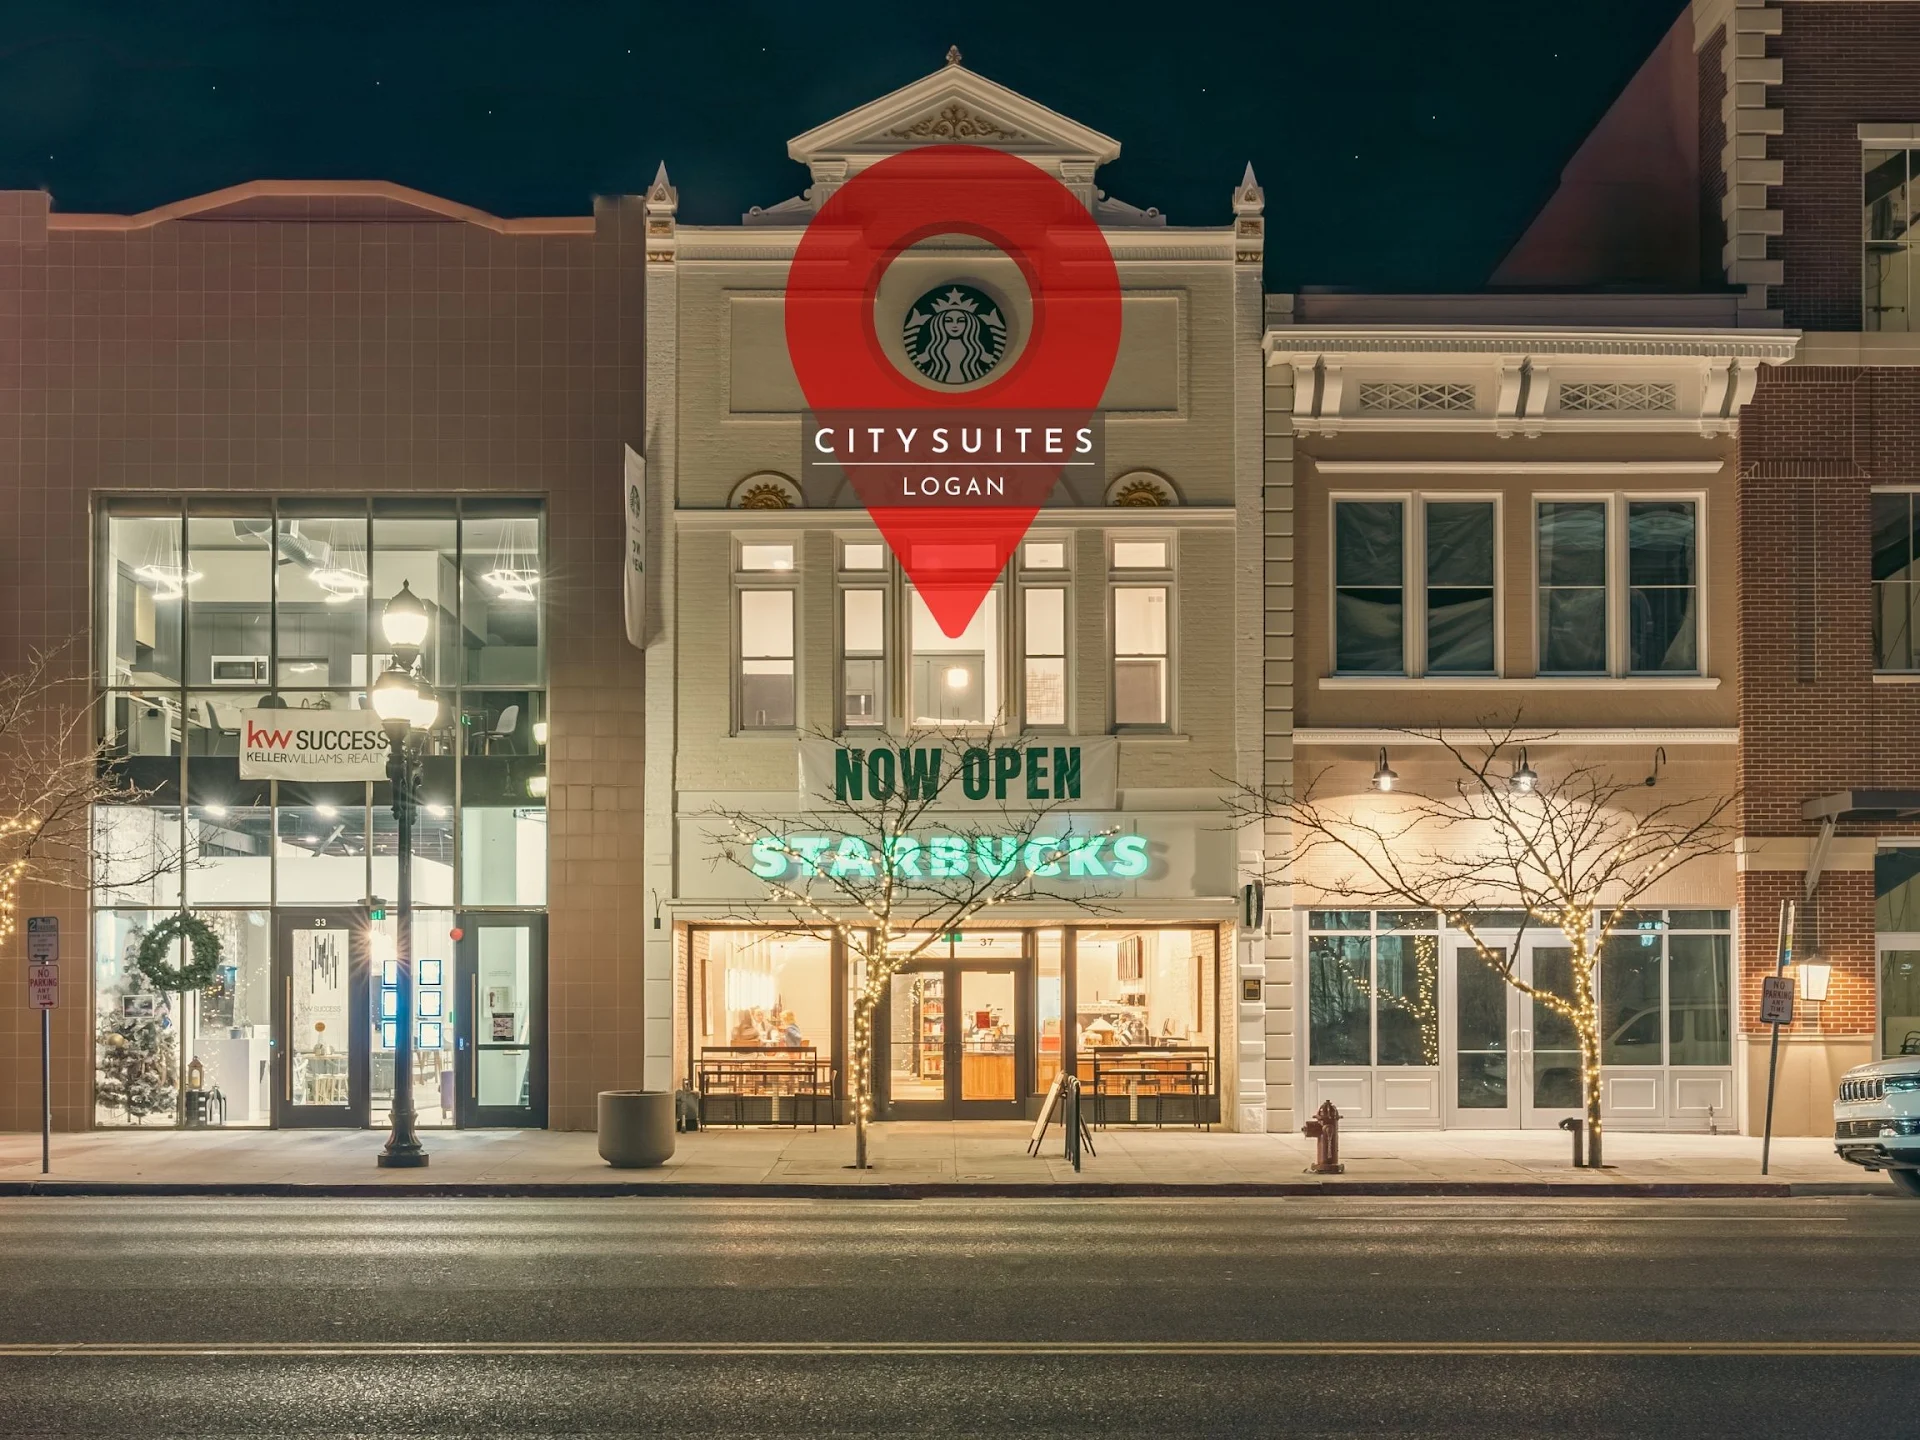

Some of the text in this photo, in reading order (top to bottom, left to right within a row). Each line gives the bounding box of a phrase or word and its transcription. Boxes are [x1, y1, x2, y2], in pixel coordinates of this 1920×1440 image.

[247, 719, 390, 750] kw SUCCESS
[835, 746, 1082, 801] NOW OPEN
[751, 835, 1149, 880] STARBUCKS
[314, 918, 327, 927] 33
[980, 938, 994, 947] 37
[38, 969, 50, 977] NO
[30, 978, 57, 987] PARKING
[1774, 981, 1786, 990] NO
[1766, 989, 1792, 1000] PARKING
